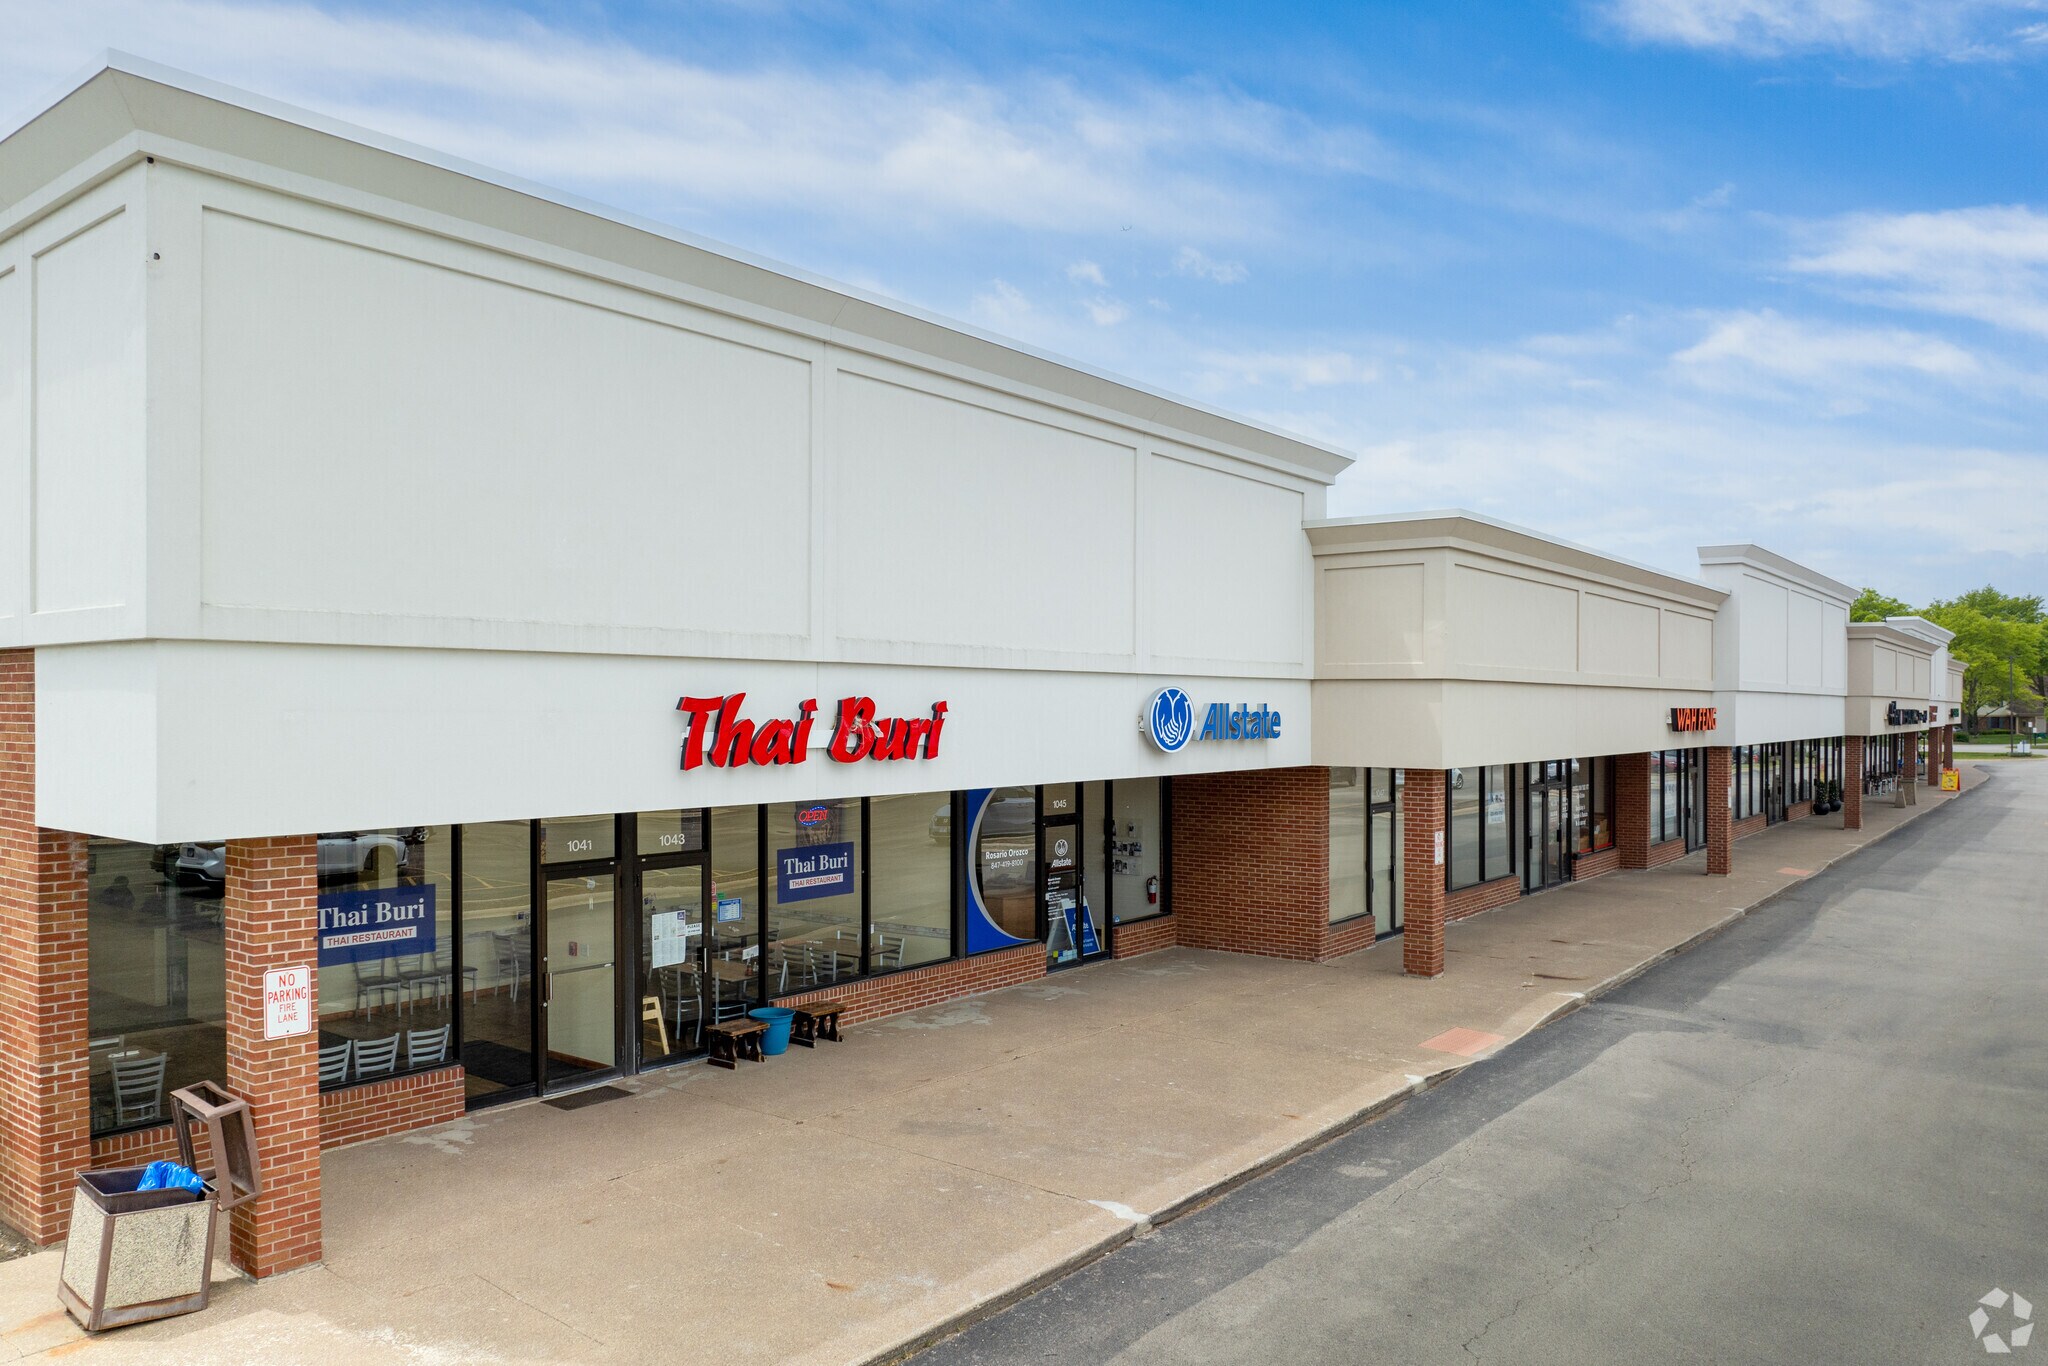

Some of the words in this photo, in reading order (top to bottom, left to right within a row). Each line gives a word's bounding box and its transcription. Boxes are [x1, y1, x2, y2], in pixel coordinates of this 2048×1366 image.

[1197, 703, 1281, 741] Allstate
[1676, 707, 1698, 731] WAH
[1699, 707, 1717, 731] FENG
[676, 692, 818, 771] Thai
[827, 696, 948, 763] Buri
[1053, 800, 1067, 808] 1045
[799, 809, 828, 822] OPEN
[567, 840, 592, 852] 1041
[659, 834, 685, 846] 1043
[985, 850, 1008, 859] Rosario
[1008, 848, 1029, 857] Orozco
[784, 855, 815, 875] Thai
[819, 852, 848, 871] Buri
[1051, 858, 1072, 868] Allstate
[792, 880, 805, 888] THAI
[805, 875, 841, 885] RESTAURANT
[318, 904, 368, 929] Thai
[375, 897, 425, 924] Buri
[327, 937, 350, 946] THAI
[352, 928, 413, 944] RESTAURANT
[278, 973, 296, 987] NO
[267, 986, 307, 1004] PARKING
[279, 1002, 296, 1012] FIRE
[277, 1012, 298, 1023] LANE
